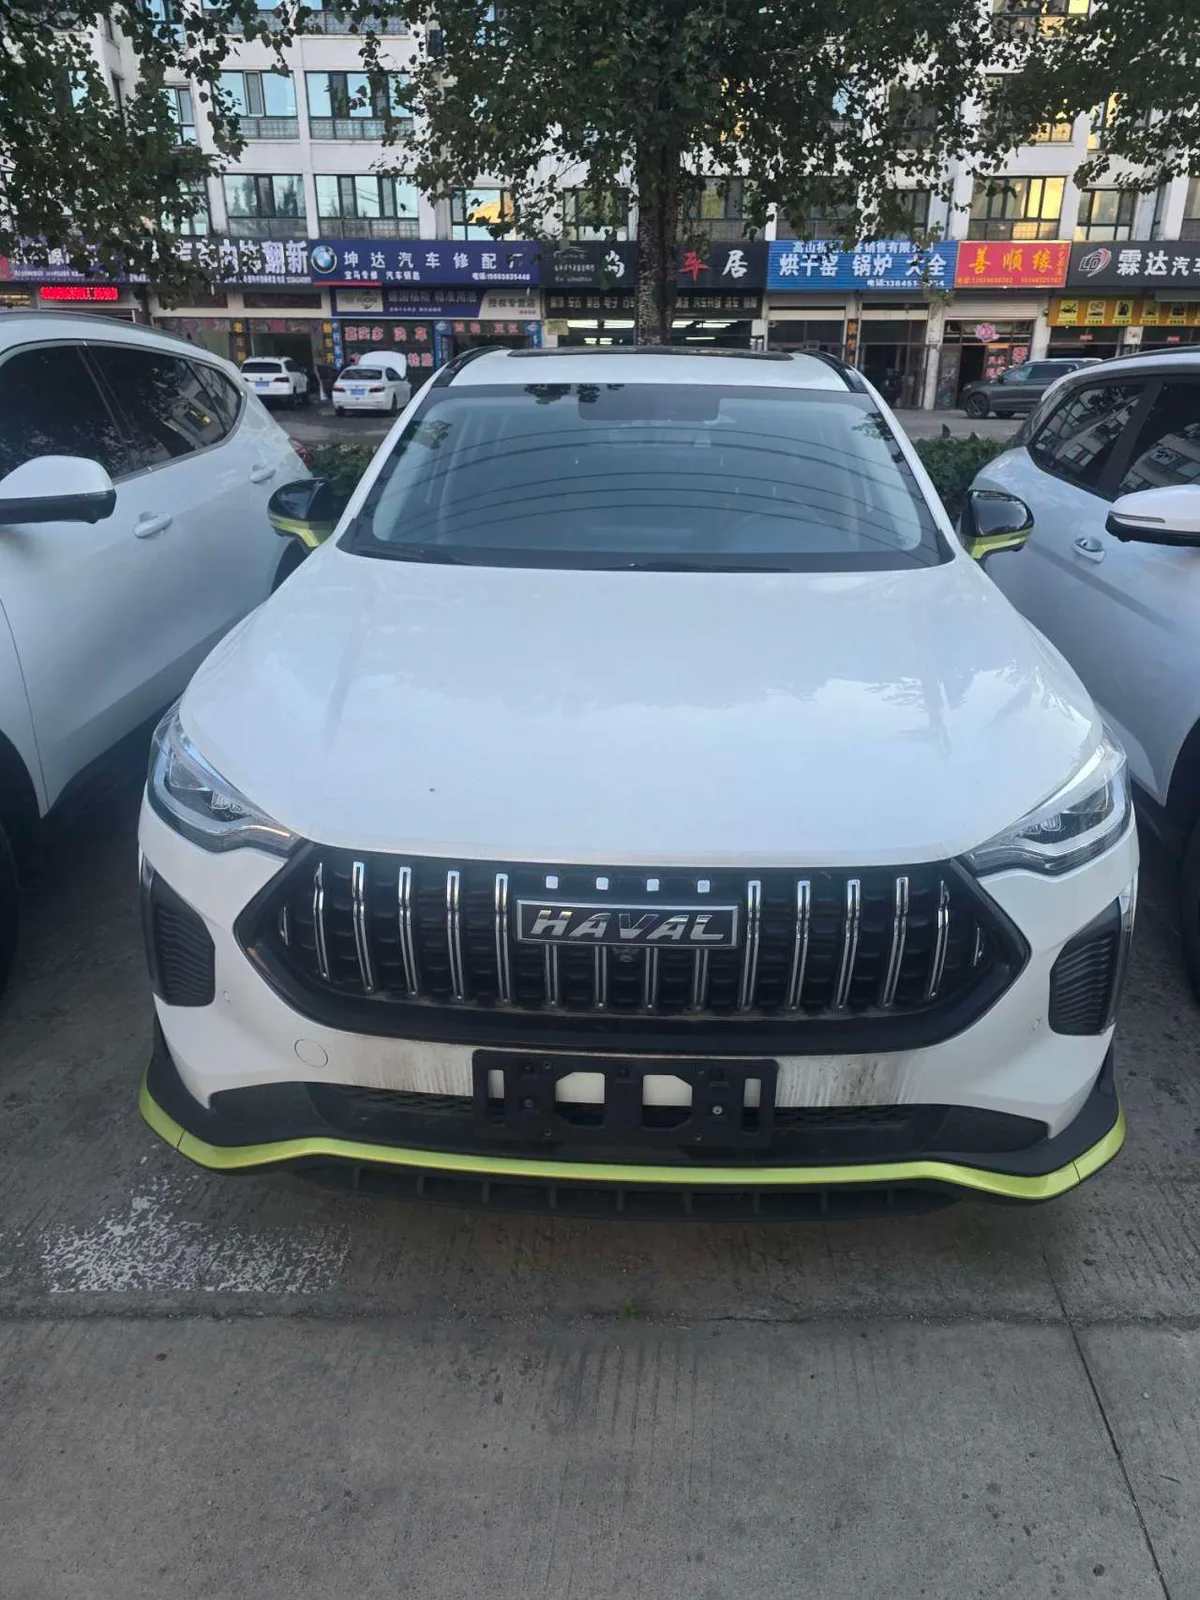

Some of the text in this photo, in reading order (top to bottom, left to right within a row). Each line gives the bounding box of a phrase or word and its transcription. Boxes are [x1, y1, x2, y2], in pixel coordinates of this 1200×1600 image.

[343, 251, 523, 269] 坤达汽车修配厂
[779, 254, 947, 276] 烘干窑 锅炉 大全
[530, 910, 725, 940] HAVAL
